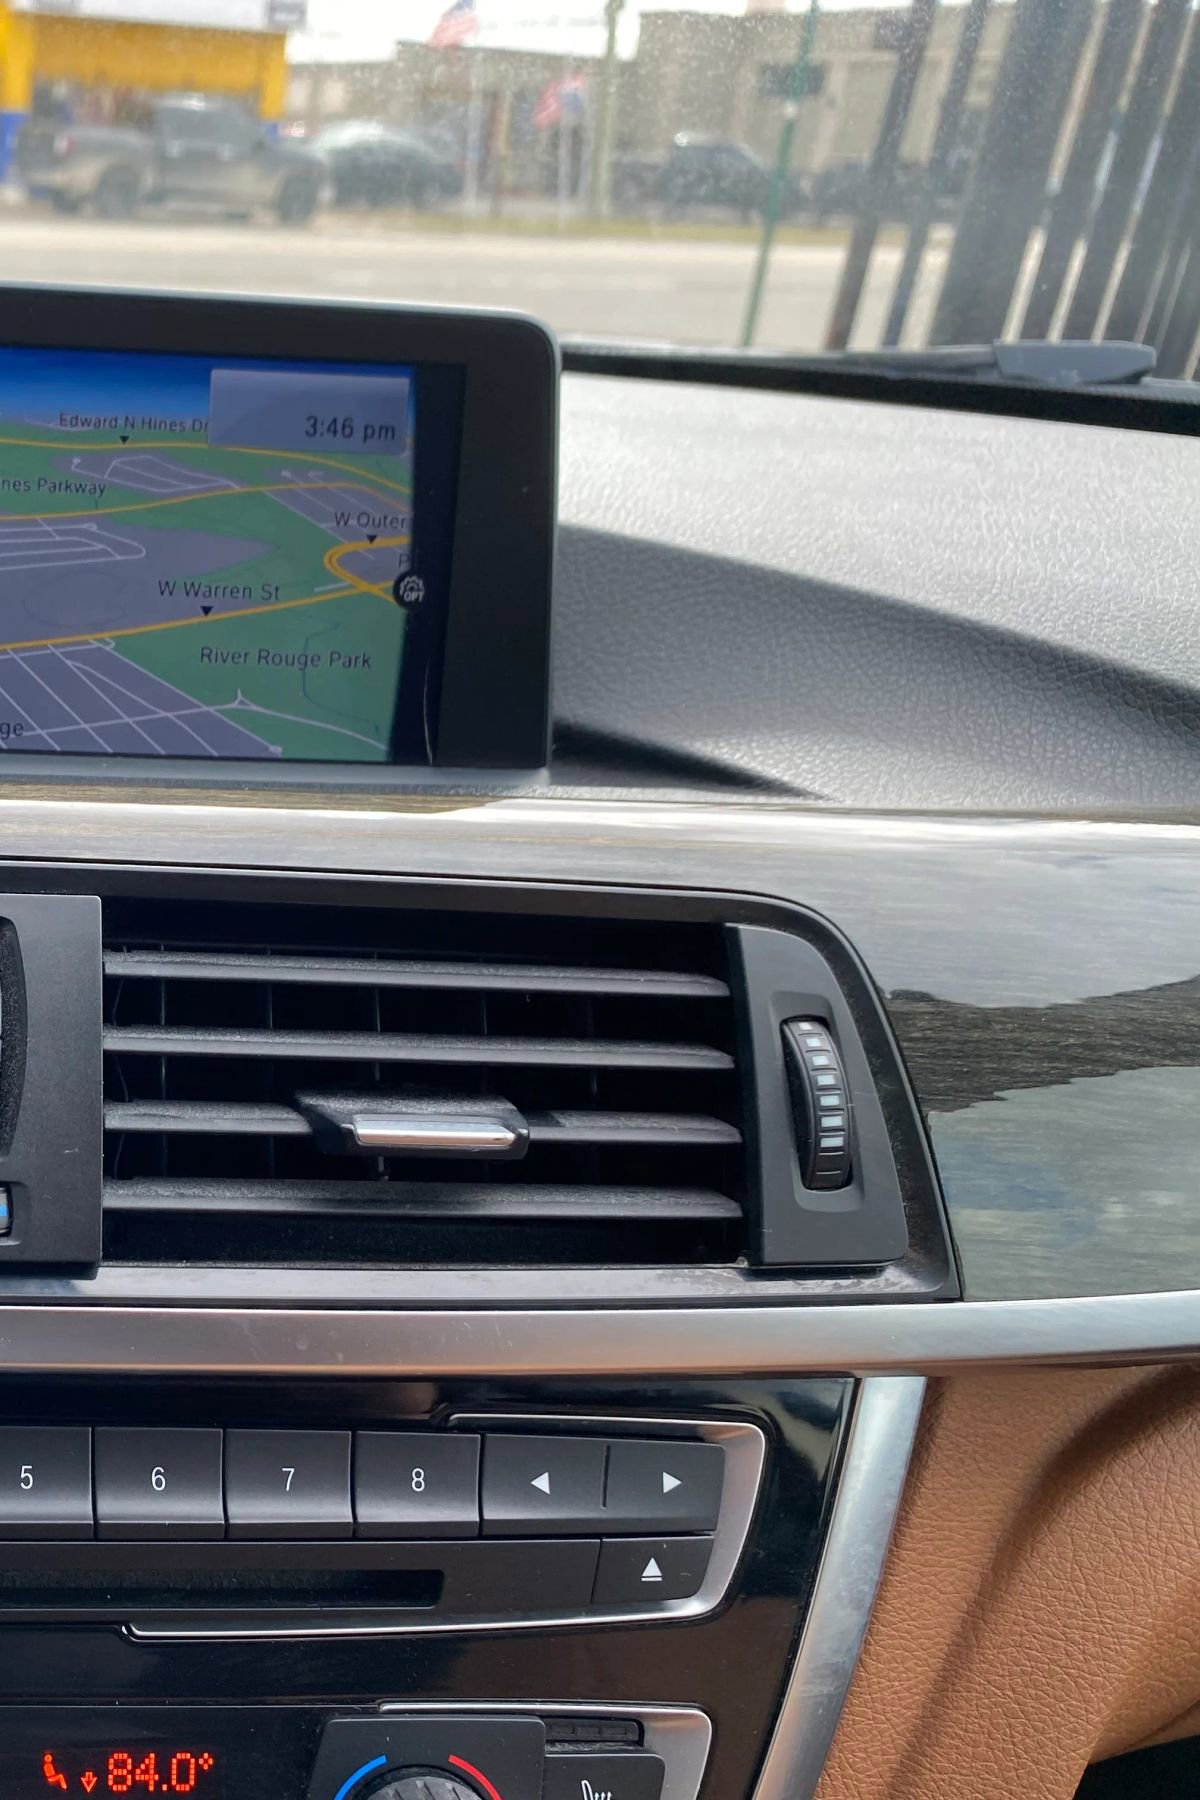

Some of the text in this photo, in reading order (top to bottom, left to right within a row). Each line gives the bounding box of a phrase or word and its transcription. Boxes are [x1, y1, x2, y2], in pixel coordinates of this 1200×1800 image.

[59, 412, 208, 433] Edward N Hines Dr
[305, 415, 396, 443] 3:46 pm
[37, 477, 106, 498] Parkway
[334, 511, 407, 529] W Outer
[158, 580, 281, 601] W Warren St
[200, 647, 372, 671] River Rouge Park
[20, 1465, 34, 1490] 5
[151, 1466, 166, 1491] 6
[281, 1467, 296, 1492] 7
[411, 1467, 426, 1492] 8
